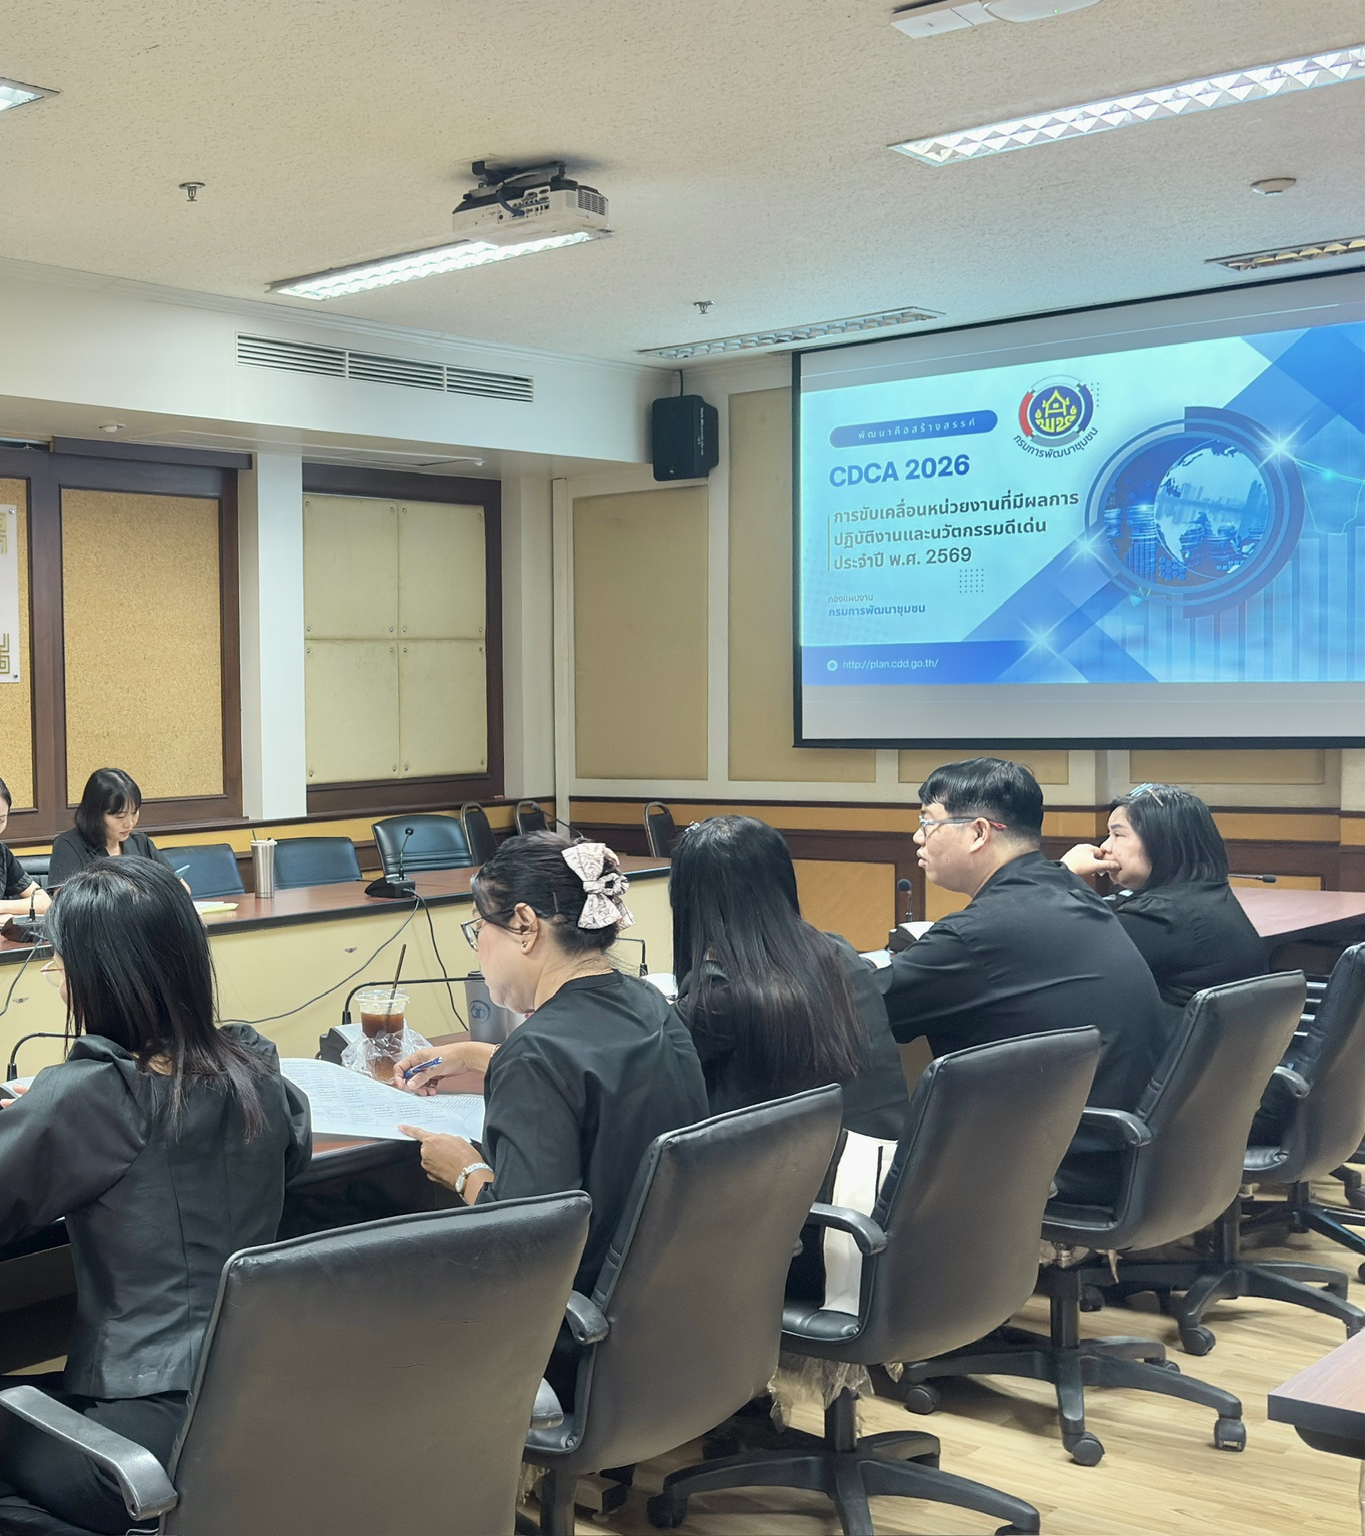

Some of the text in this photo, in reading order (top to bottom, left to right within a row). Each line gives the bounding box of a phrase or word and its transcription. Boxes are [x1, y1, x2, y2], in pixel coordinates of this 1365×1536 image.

[858, 417, 976, 439] พัฒนาคือสร้างสรรค์
[1013, 426, 1099, 459] กรมการพัฒนาชุมชน
[828, 453, 971, 487] CDCA 2026
[833, 489, 1080, 524] การขับเคลื่อนหน่วยงานที่มีผลการ
[833, 516, 1048, 549] ปฏิบัติงานและนวัตกรรมดีเด่น
[833, 546, 973, 571] ประจำปี พ.ศ. 2569
[828, 604, 926, 617] กรมการพัฒนาชุมชน
[842, 658, 939, 671] http://plan.cdd.go.th/
